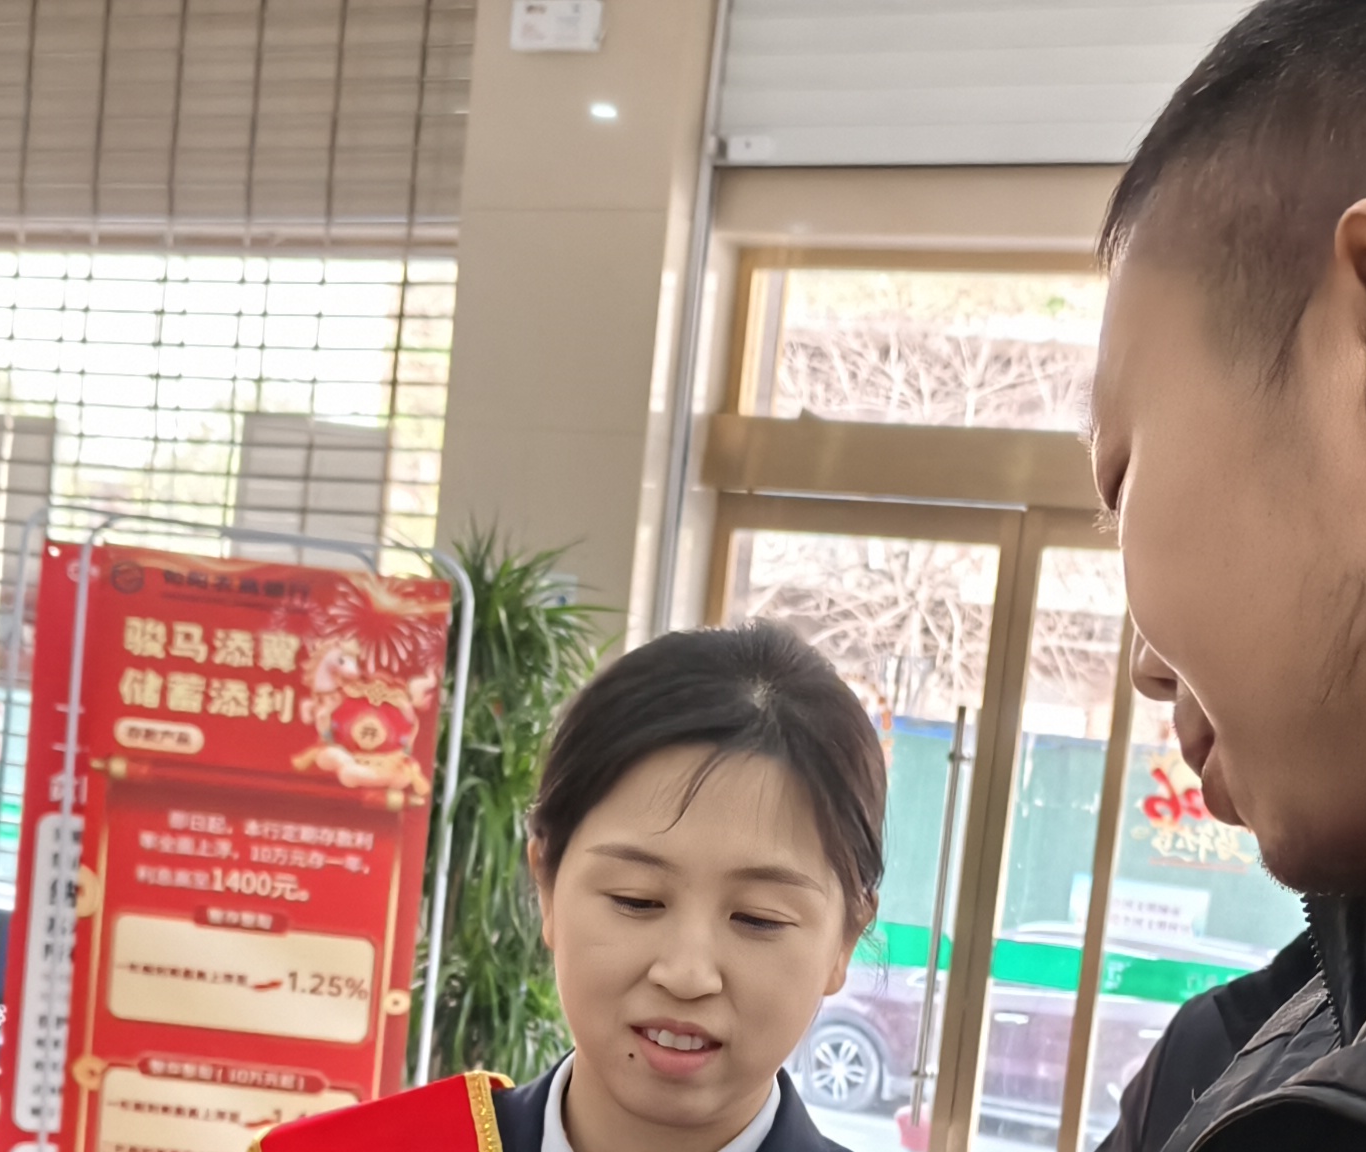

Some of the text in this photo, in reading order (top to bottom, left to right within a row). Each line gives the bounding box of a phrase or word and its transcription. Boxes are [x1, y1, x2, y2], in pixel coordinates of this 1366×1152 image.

[118, 666, 295, 725] 储蓄添利
[288, 971, 370, 1001] 1.25%
